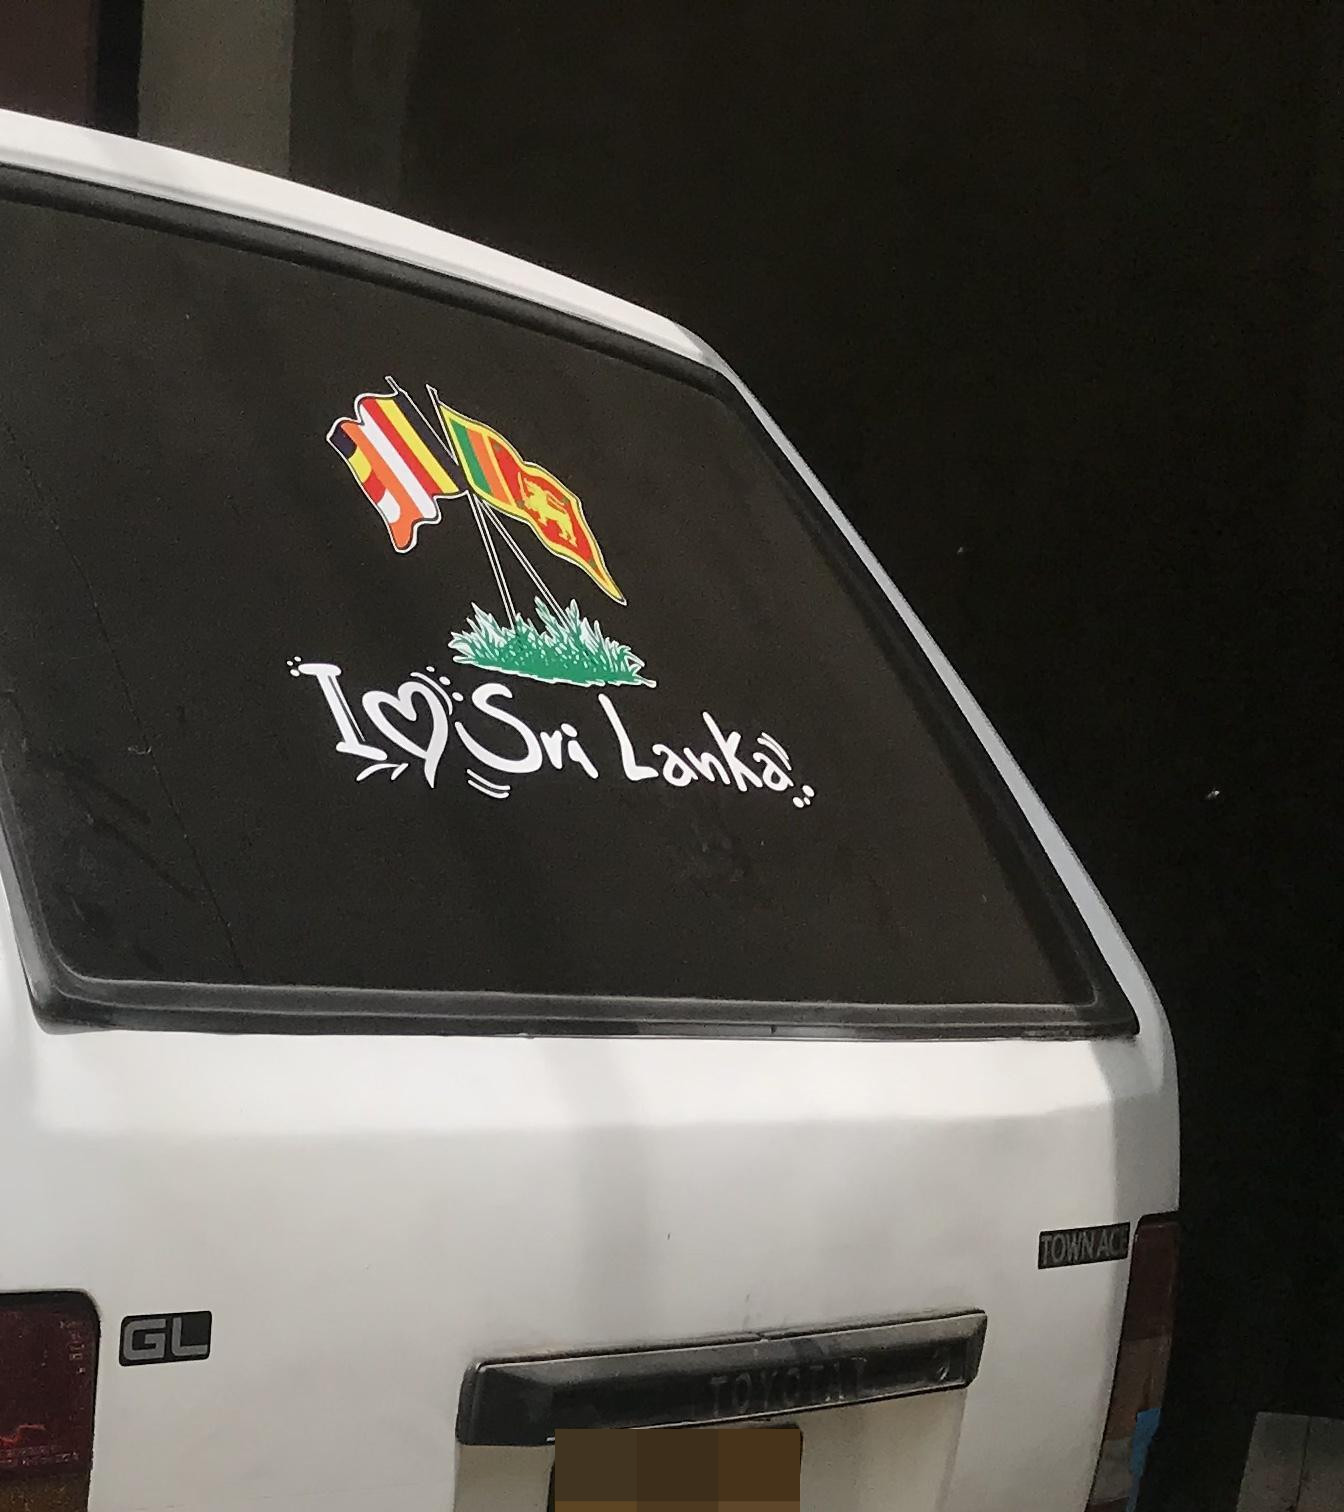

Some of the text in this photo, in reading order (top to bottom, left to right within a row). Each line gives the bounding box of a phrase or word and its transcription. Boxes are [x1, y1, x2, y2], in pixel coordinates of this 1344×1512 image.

[299, 661, 794, 793] I Sri Lanka
[123, 1316, 209, 1361] GL
